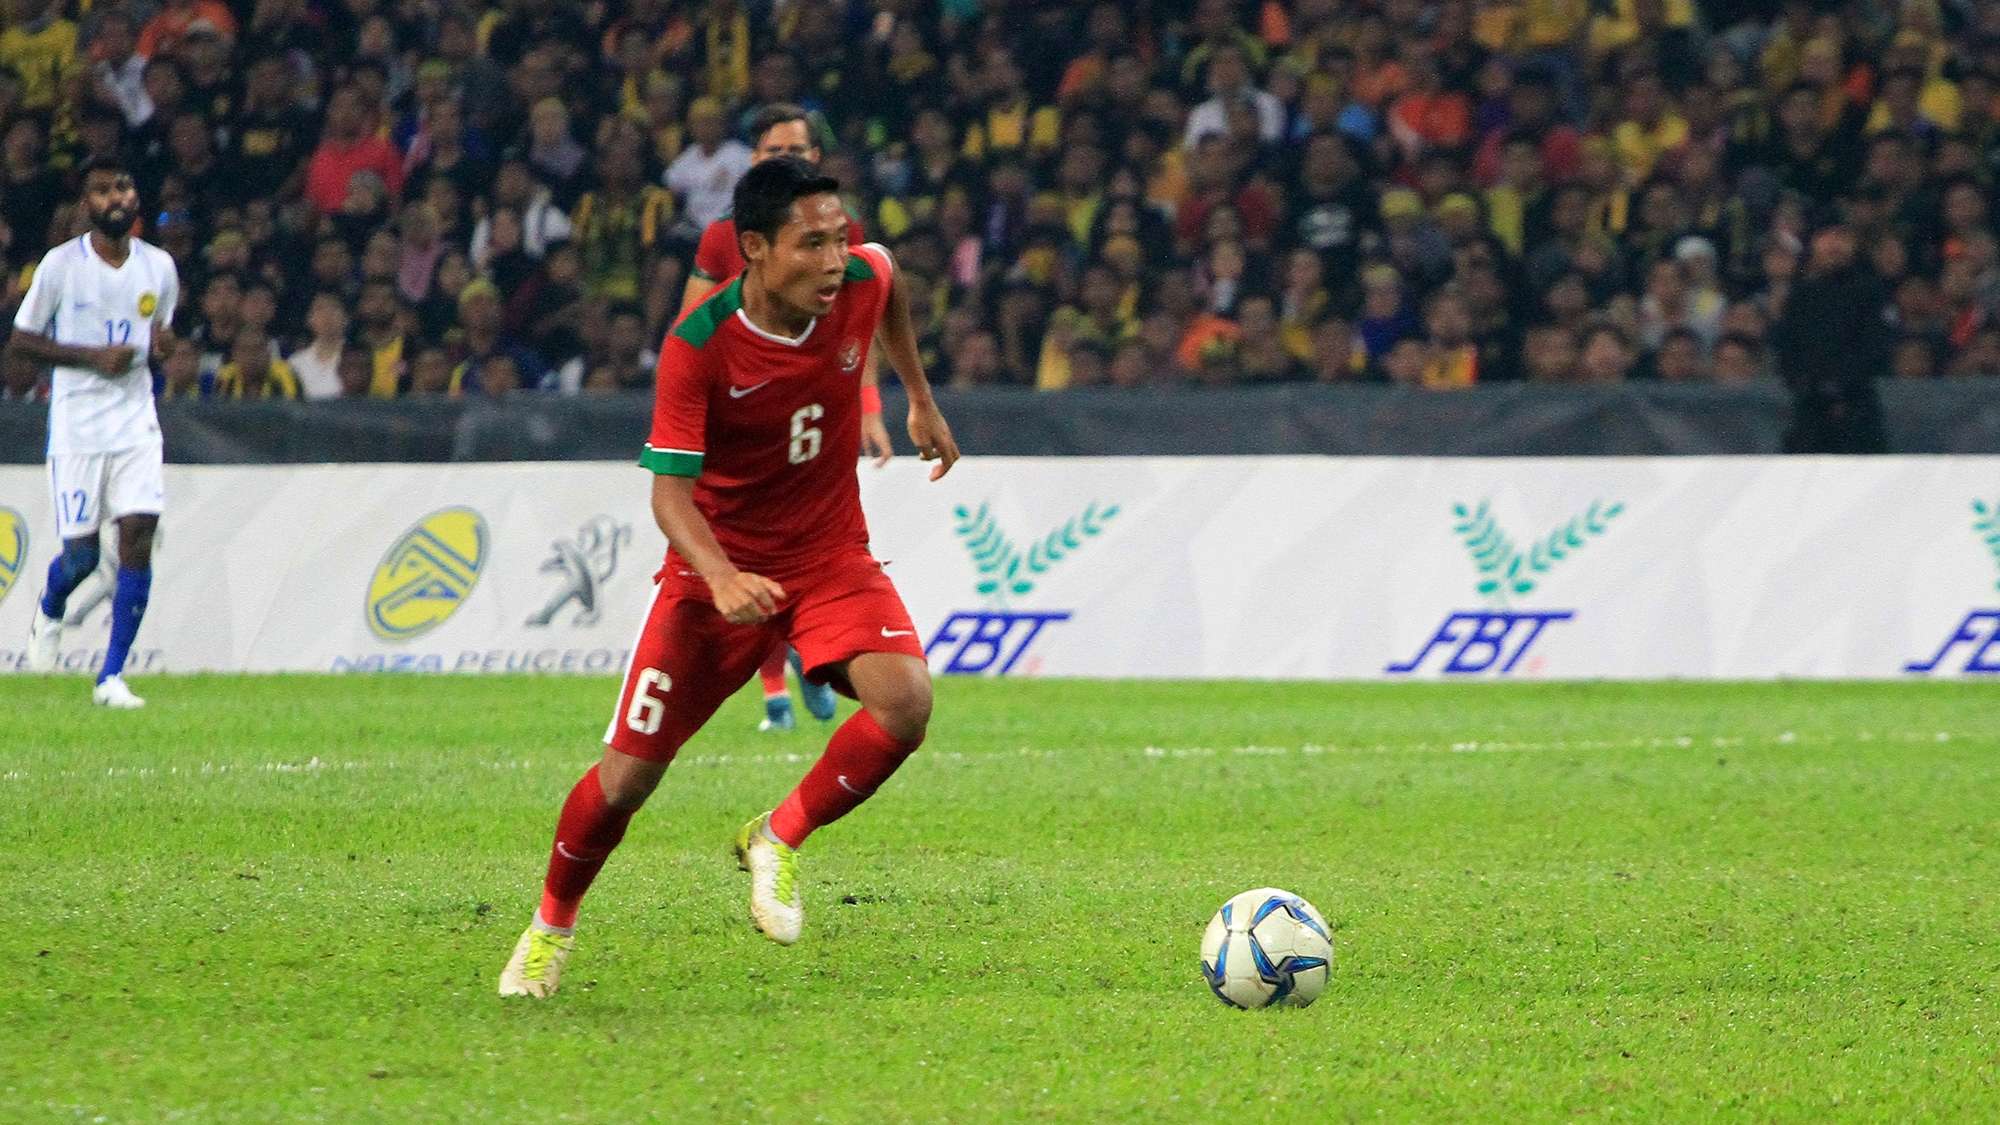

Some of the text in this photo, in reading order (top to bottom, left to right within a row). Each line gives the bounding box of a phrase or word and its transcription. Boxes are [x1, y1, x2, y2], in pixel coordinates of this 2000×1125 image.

[104, 319, 132, 346] 12
[788, 404, 824, 464] 6
[61, 489, 90, 524] 12
[924, 611, 1072, 675] FBT
[1386, 611, 1576, 673] FBT
[626, 667, 673, 735] 6
